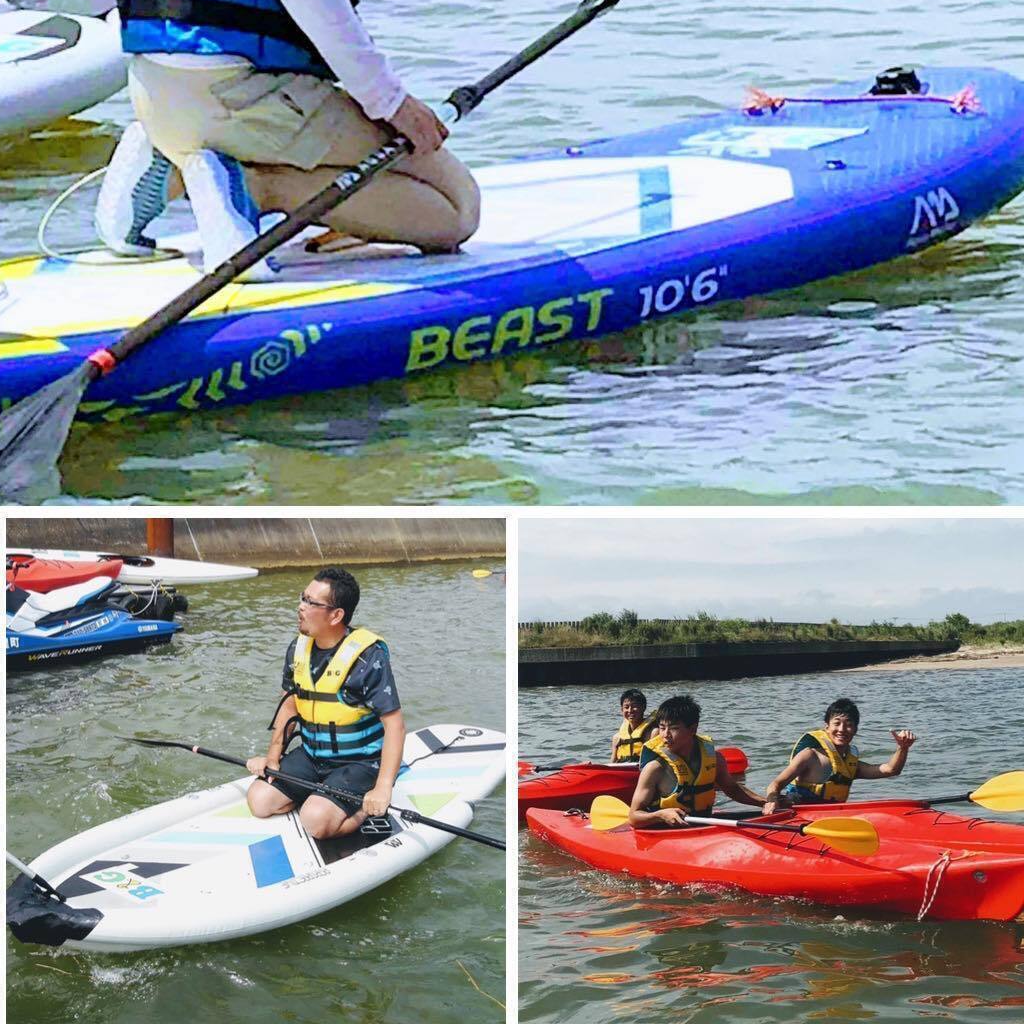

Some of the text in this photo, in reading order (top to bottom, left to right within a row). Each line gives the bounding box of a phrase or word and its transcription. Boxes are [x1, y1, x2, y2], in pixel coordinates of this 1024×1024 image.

[405, 263, 729, 373] BEAST 10'6"
[6, 636, 20, 649] 町
